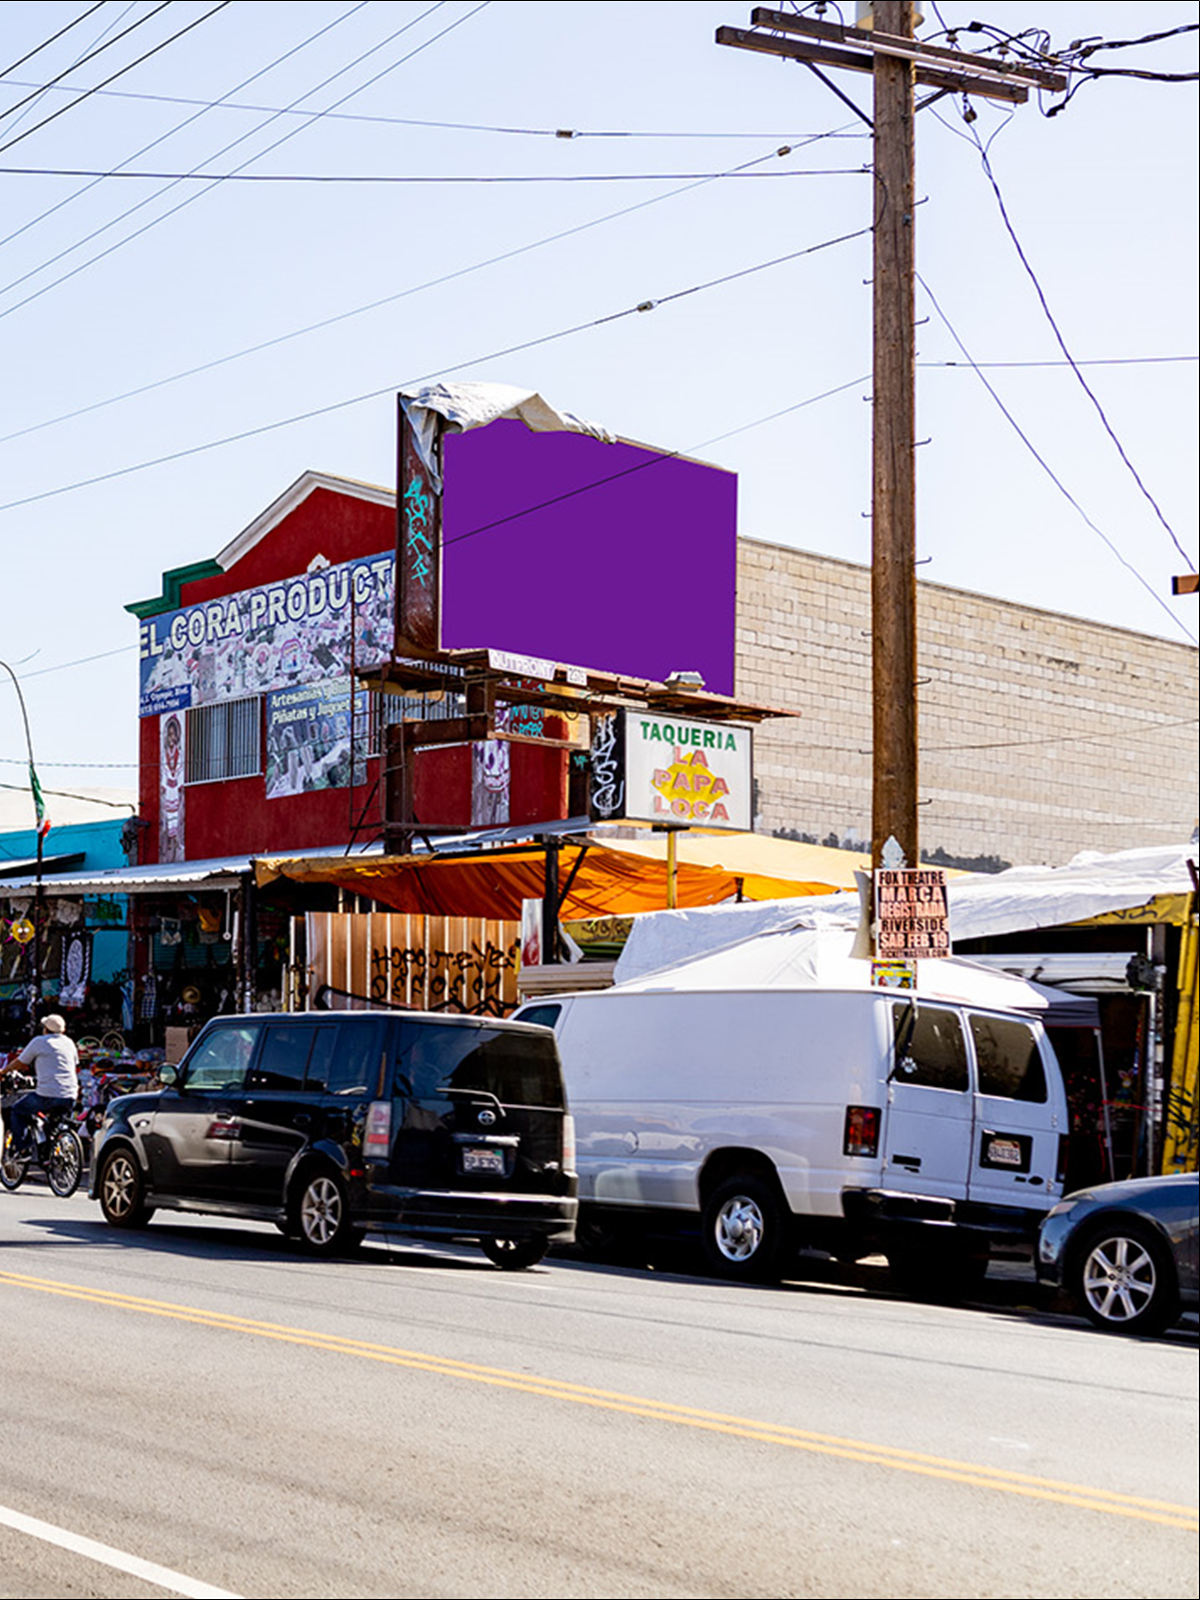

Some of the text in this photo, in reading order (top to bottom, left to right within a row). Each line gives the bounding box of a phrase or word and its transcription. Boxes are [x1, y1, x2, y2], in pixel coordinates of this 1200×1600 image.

[140, 558, 396, 658] EL CORA PRODUCT
[491, 651, 555, 679] OUTFRONT
[318, 698, 362, 718] Juguets
[640, 721, 737, 751] TAQUERIA
[674, 746, 709, 768] LA
[654, 769, 730, 795] PAPA
[654, 796, 730, 821] LOCA
[879, 871, 944, 885] FOX THEATRE
[881, 886, 943, 902] MARCA
[880, 902, 946, 918] REGISTRADA
[881, 919, 945, 932] RIVERSIDE
[880, 931, 948, 948] SAB FEB 19
